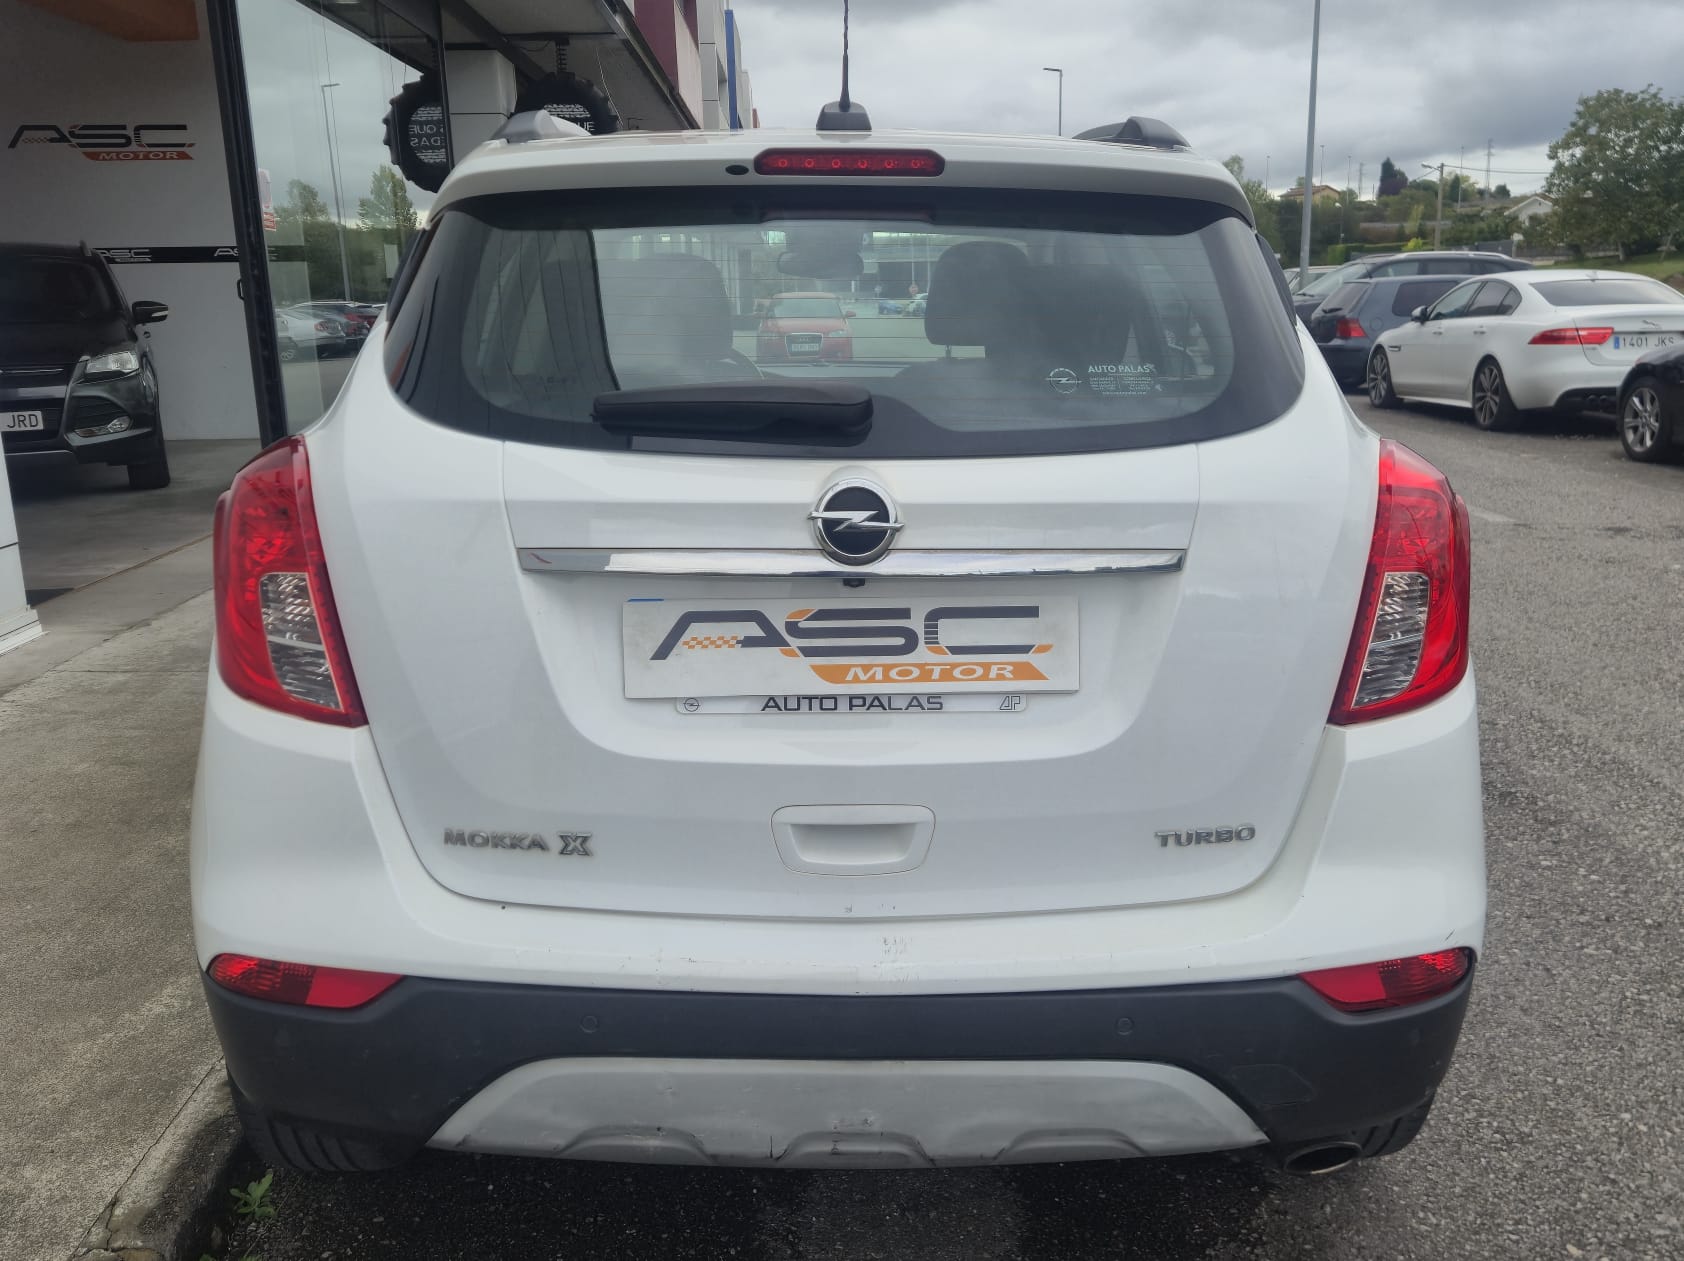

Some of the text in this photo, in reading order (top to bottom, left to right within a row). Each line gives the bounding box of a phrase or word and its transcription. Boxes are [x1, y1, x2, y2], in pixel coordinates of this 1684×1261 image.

[8, 124, 196, 148] ASC
[99, 151, 179, 160] MOTOR
[1622, 336, 1648, 348] 1401
[1087, 364, 1151, 373] AUTO PALAS
[7, 413, 41, 429] JRD
[649, 606, 1054, 661] ASC
[845, 664, 1015, 681] MOTOR
[761, 696, 838, 711] AUTO
[848, 695, 944, 711] PALAS
[444, 828, 593, 856] MOKKA X
[1154, 825, 1256, 847] TURBO
